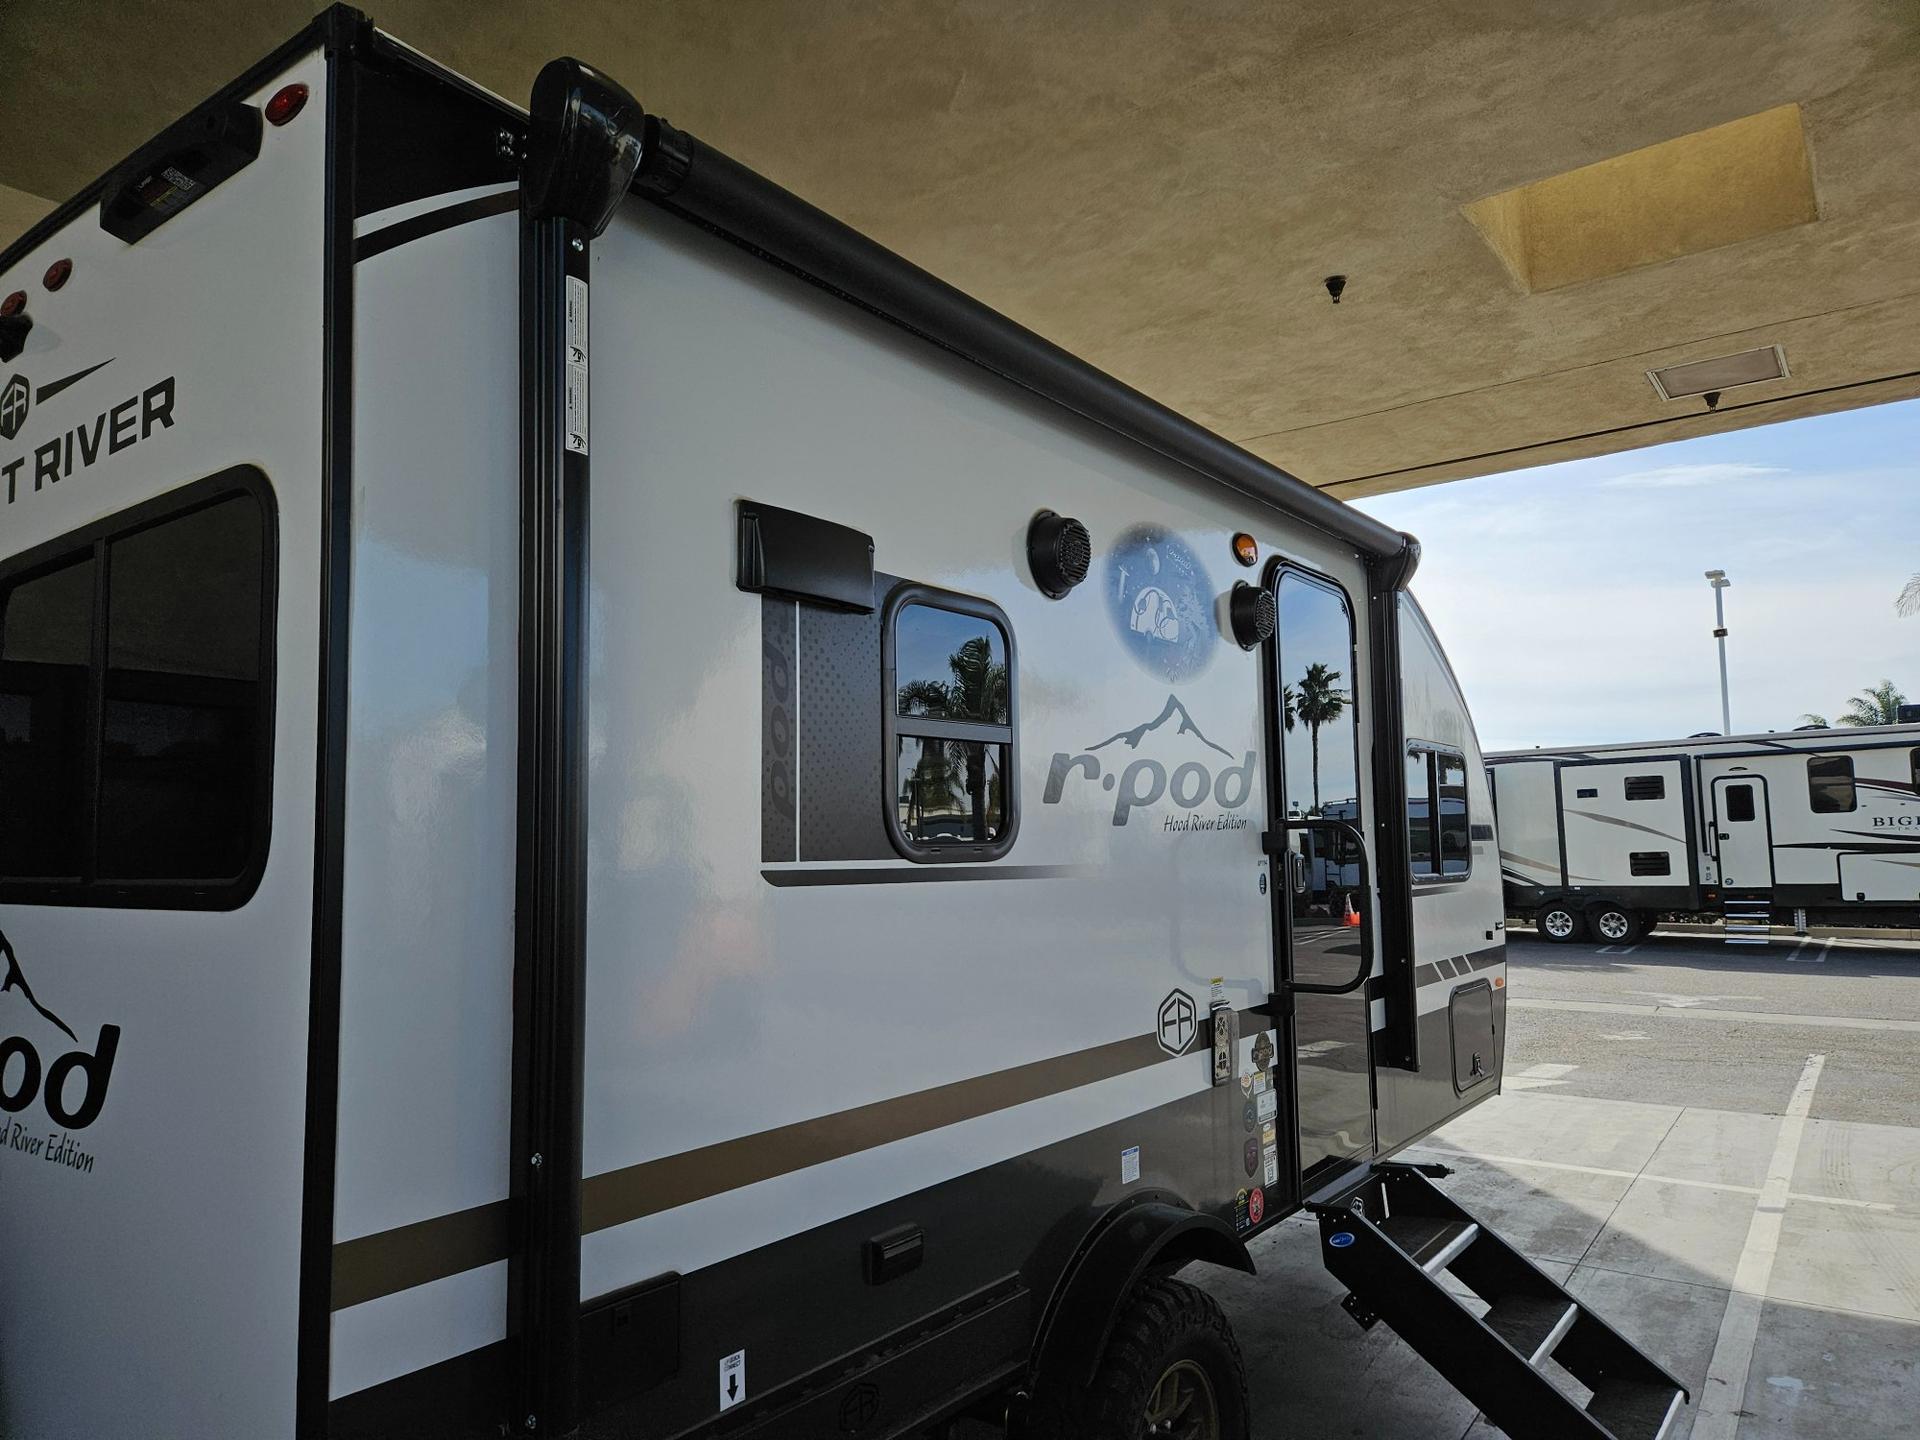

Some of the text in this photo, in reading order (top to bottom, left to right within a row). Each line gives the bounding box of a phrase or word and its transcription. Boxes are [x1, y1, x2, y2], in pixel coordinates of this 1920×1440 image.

[34, 376, 176, 491] RIVER
[1164, 811, 1248, 833] Hood River Edition
[10, 1123, 44, 1156] River
[45, 1132, 94, 1174] Edition
